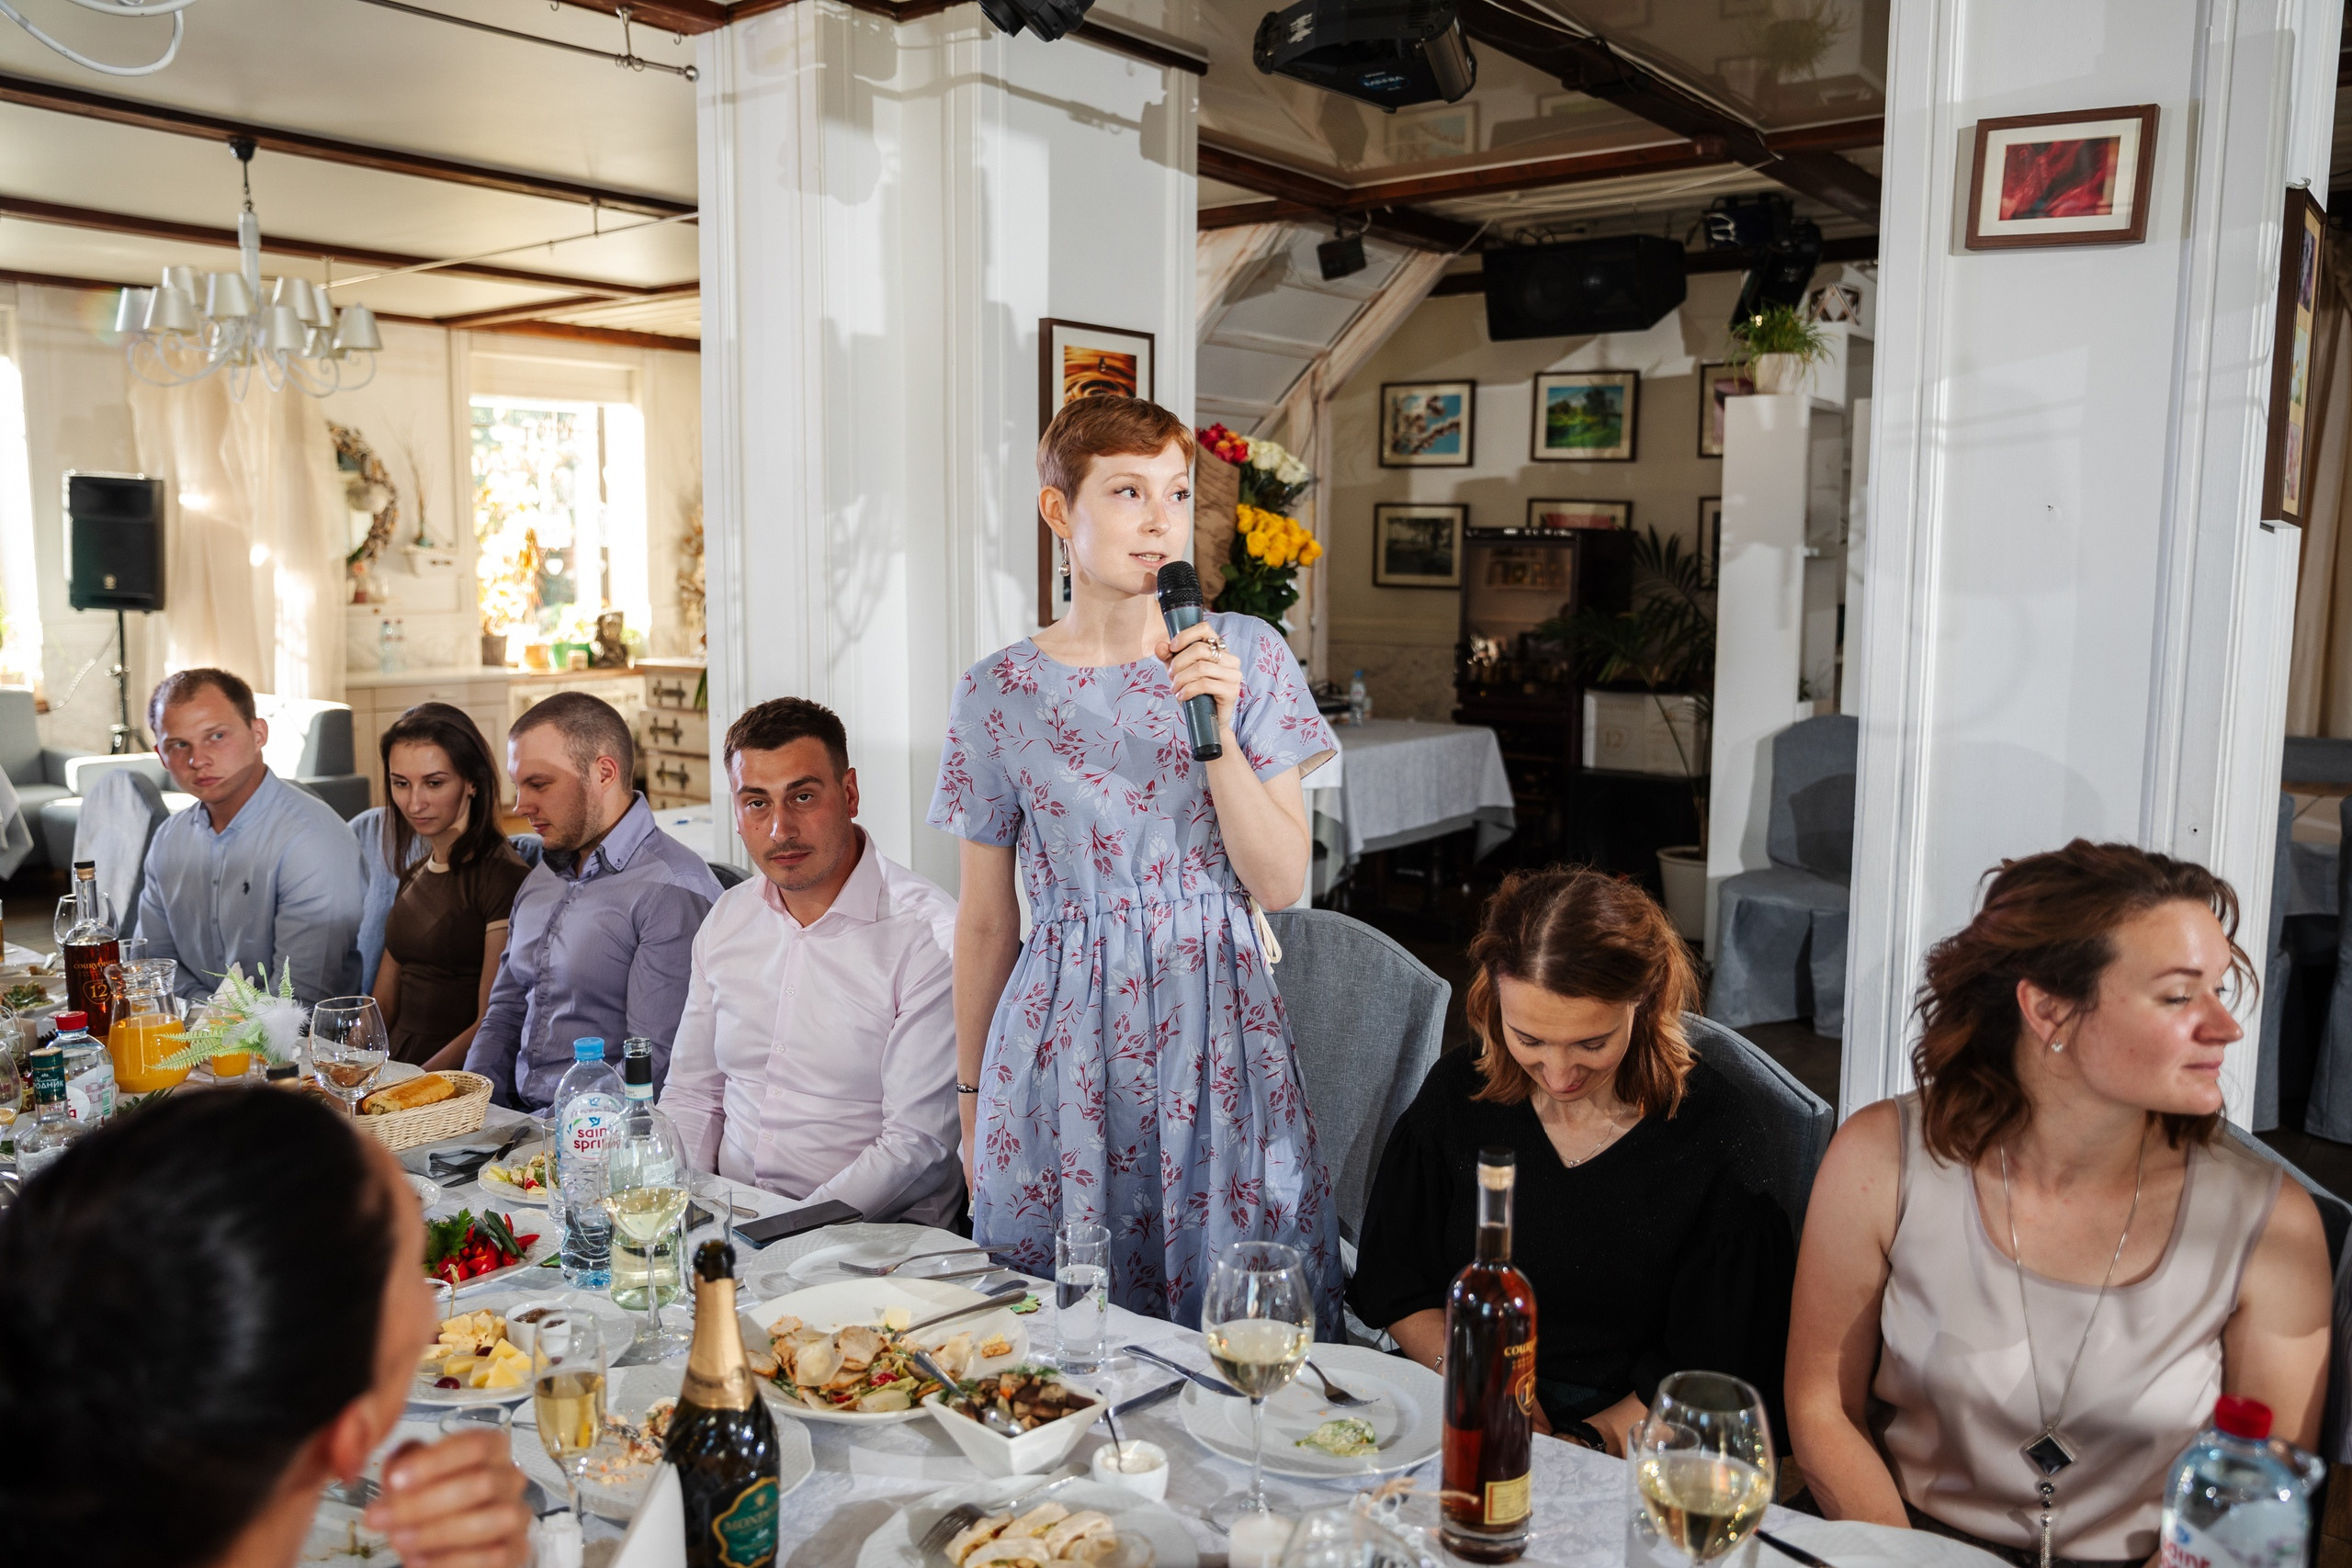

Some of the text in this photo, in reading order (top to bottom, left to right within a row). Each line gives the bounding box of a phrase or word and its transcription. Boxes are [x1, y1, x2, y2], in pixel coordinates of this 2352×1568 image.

[74, 959, 117, 970] COURVOISIE
[89, 984, 108, 998] 12
[577, 1127, 616, 1138] sain
[1504, 1336, 1537, 1357] COUR
